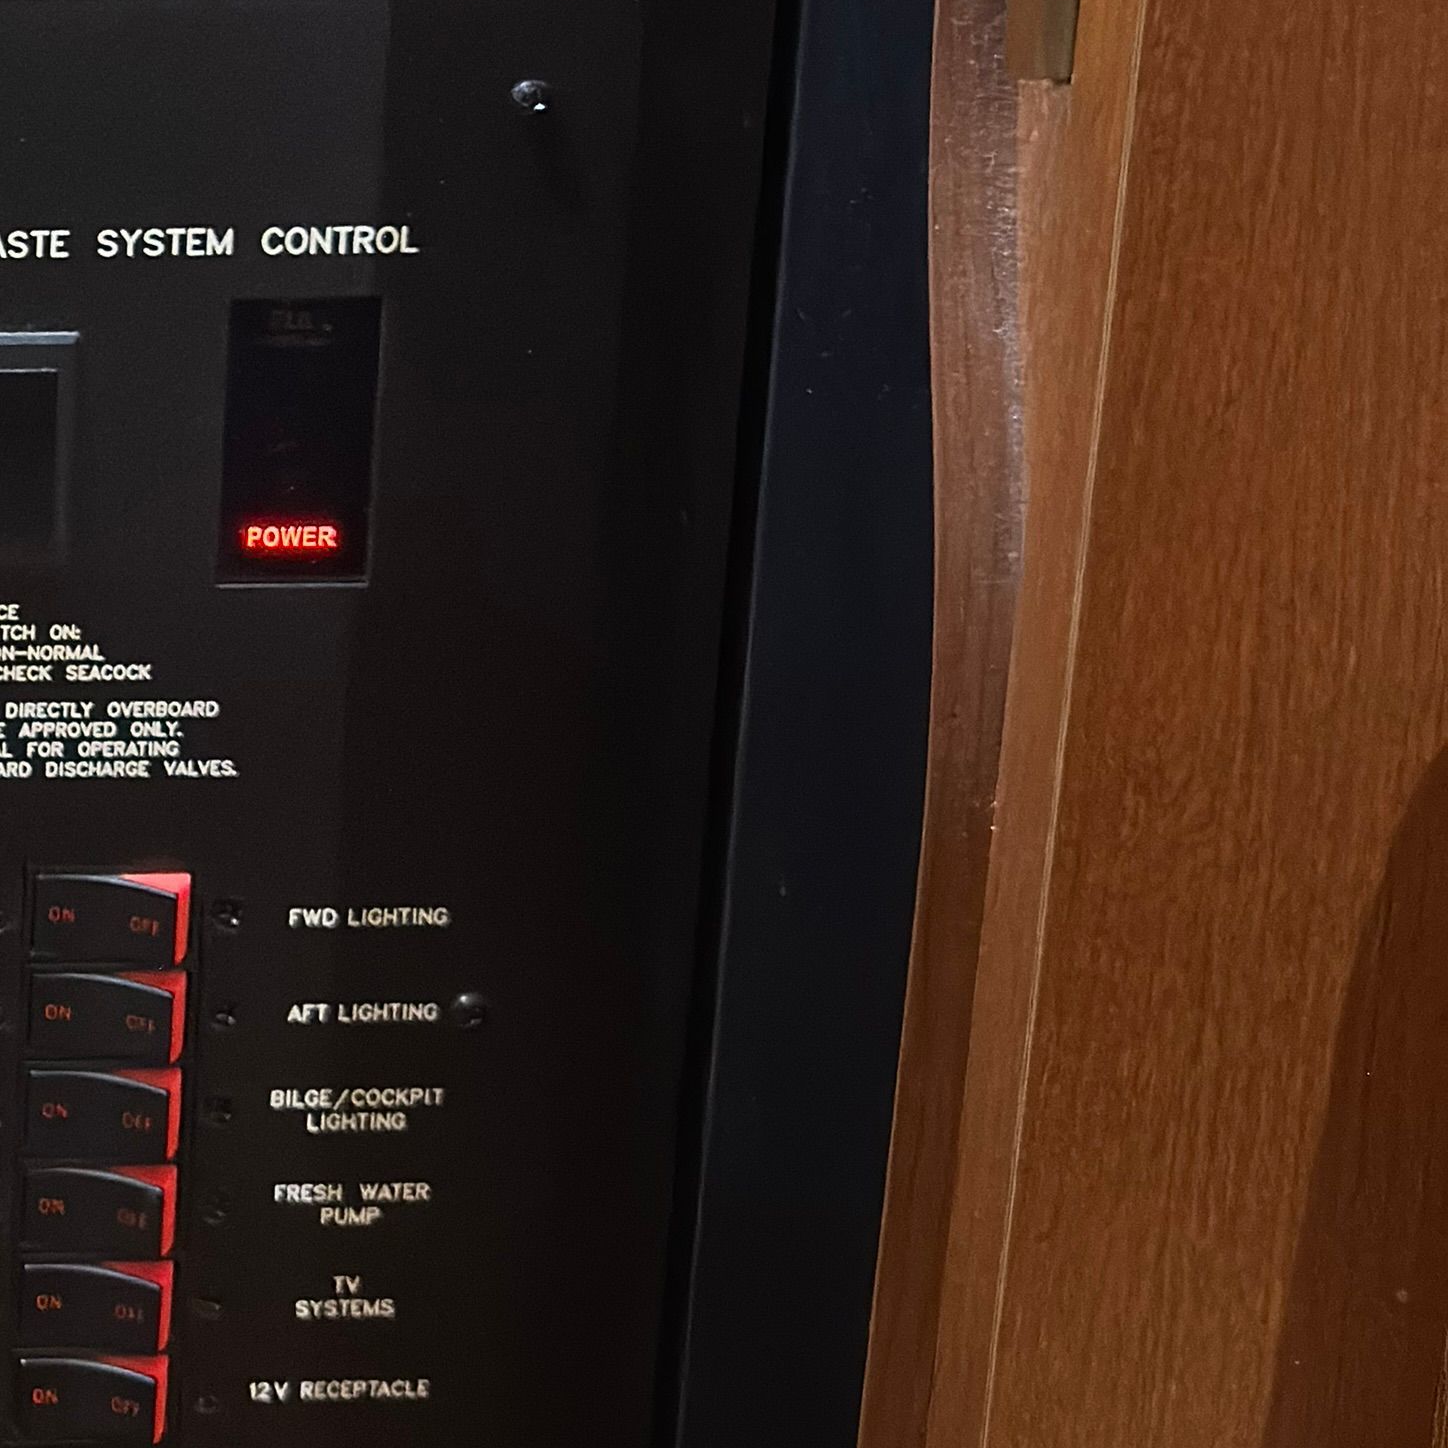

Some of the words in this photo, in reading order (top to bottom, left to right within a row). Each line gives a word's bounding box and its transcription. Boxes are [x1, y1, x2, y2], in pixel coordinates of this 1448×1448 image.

[98, 228, 233, 257] SYSTEM
[261, 226, 418, 255] CONTROL
[246, 525, 337, 548] POWER
[50, 624, 80, 640] ON:
[66, 664, 151, 681] SEACOCK
[6, 702, 94, 719] DIRECTLY
[107, 701, 219, 717] OVERBOARD
[289, 908, 338, 927] FWD
[348, 908, 447, 926] LIGHTING
[288, 1004, 328, 1023] AFT
[338, 1003, 436, 1022] LIGHTING
[270, 1088, 442, 1110] BILGE/COCKPIT
[307, 1112, 405, 1132] LIGHTING
[275, 1184, 342, 1203] FRESH
[360, 1183, 429, 1200] WATER
[321, 1207, 379, 1224] PUMP
[334, 1276, 359, 1293] TV
[296, 1299, 394, 1318] SYSTEMS
[250, 1382, 288, 1401] 12V
[300, 1380, 428, 1399] RECEPTACLE
